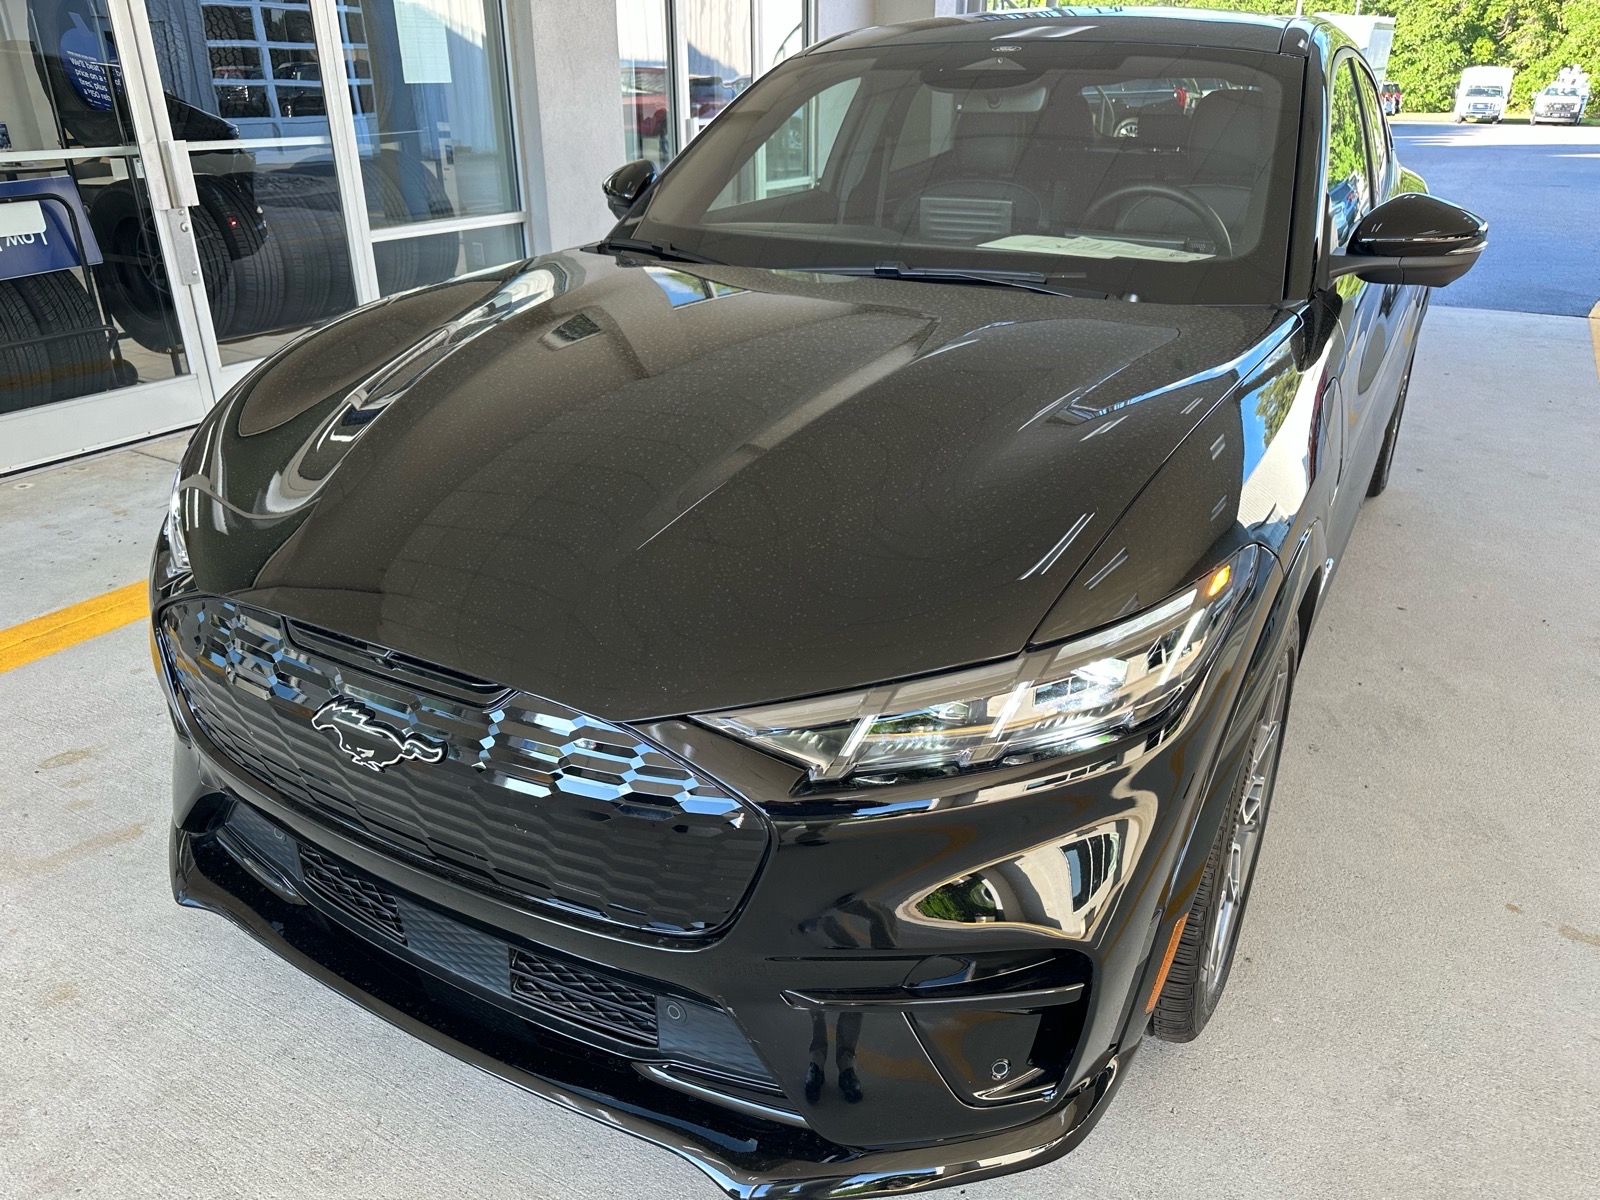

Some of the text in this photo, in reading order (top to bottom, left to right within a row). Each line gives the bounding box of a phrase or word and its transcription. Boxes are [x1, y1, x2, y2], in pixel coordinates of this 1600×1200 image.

[85, 62, 100, 71] beat
[75, 69, 90, 78] price
[94, 83, 108, 92] plus
